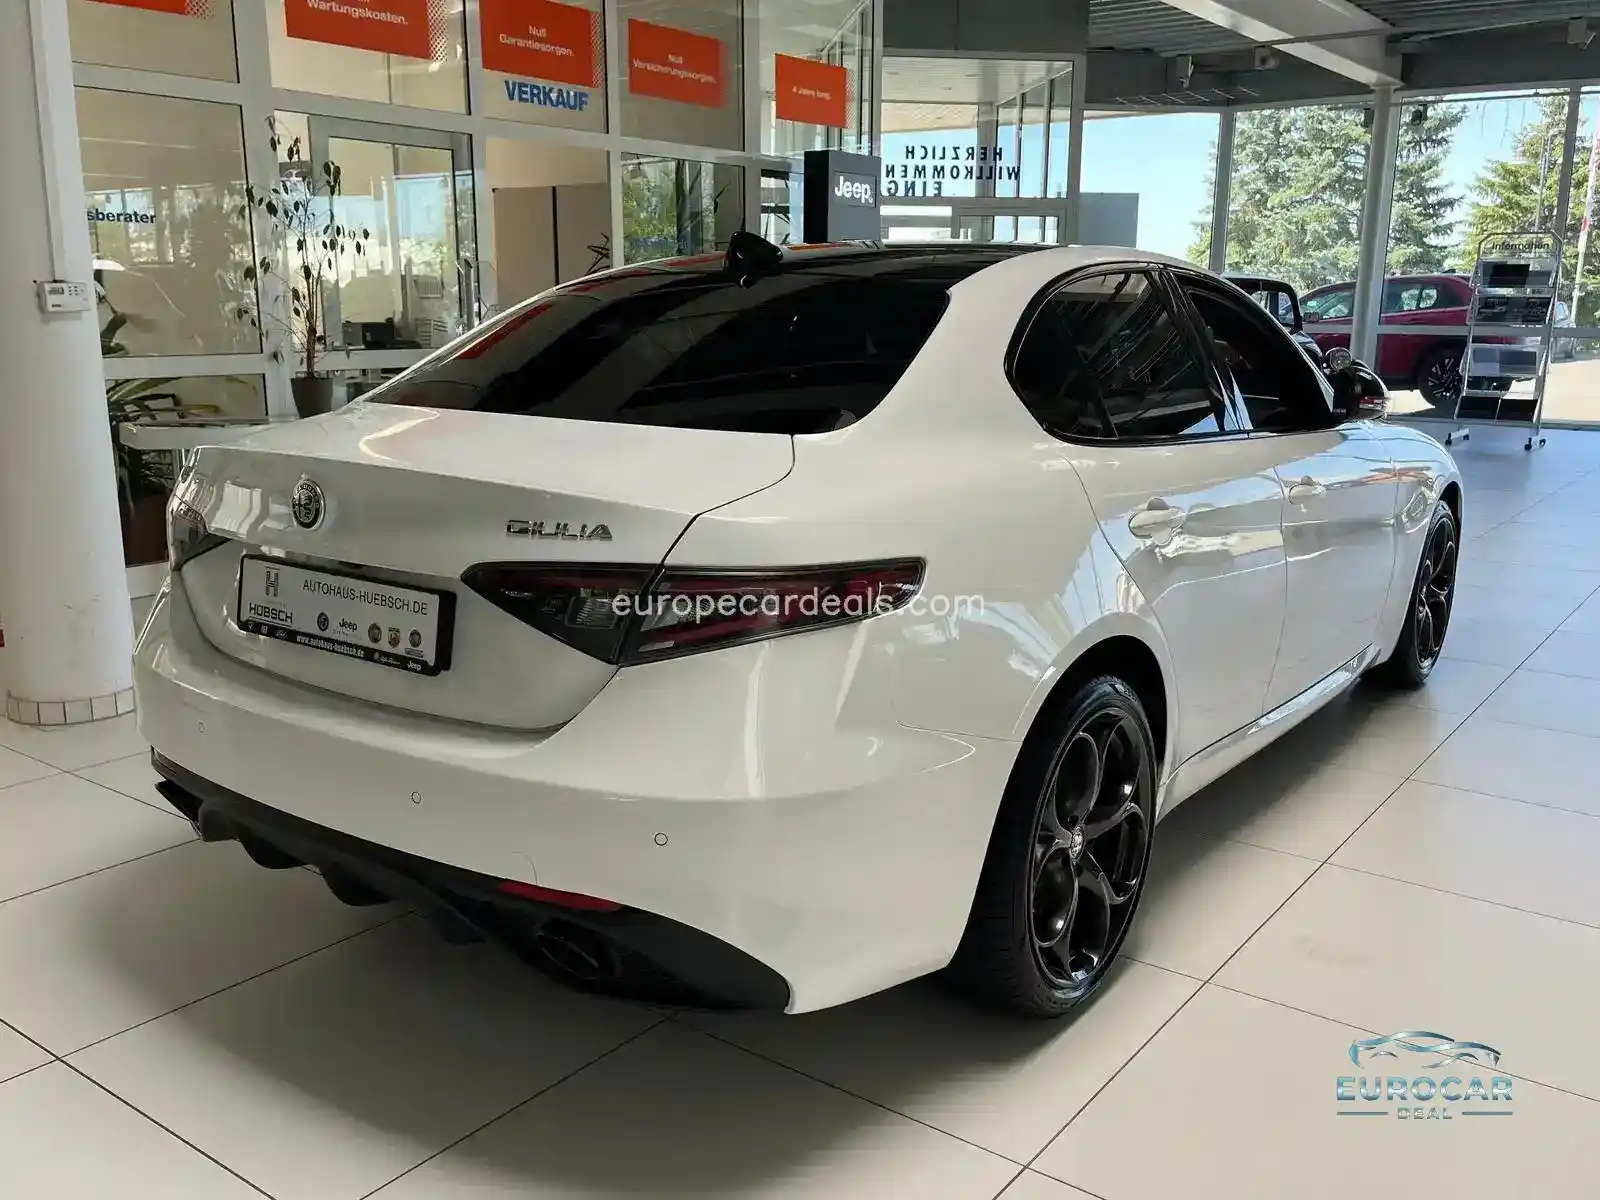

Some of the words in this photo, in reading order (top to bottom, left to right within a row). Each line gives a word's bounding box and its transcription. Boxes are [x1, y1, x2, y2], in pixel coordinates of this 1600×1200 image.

[307, 0, 409, 25] Wartungskosten.
[499, 33, 575, 56] Garantiesorgen.
[504, 79, 589, 111] VERKAUF
[834, 175, 872, 203] Jeep
[506, 519, 613, 541] GIULIA
[302, 579, 428, 616] AUTOHAUS-HUEBSCH.DE
[339, 618, 358, 632] Jeep
